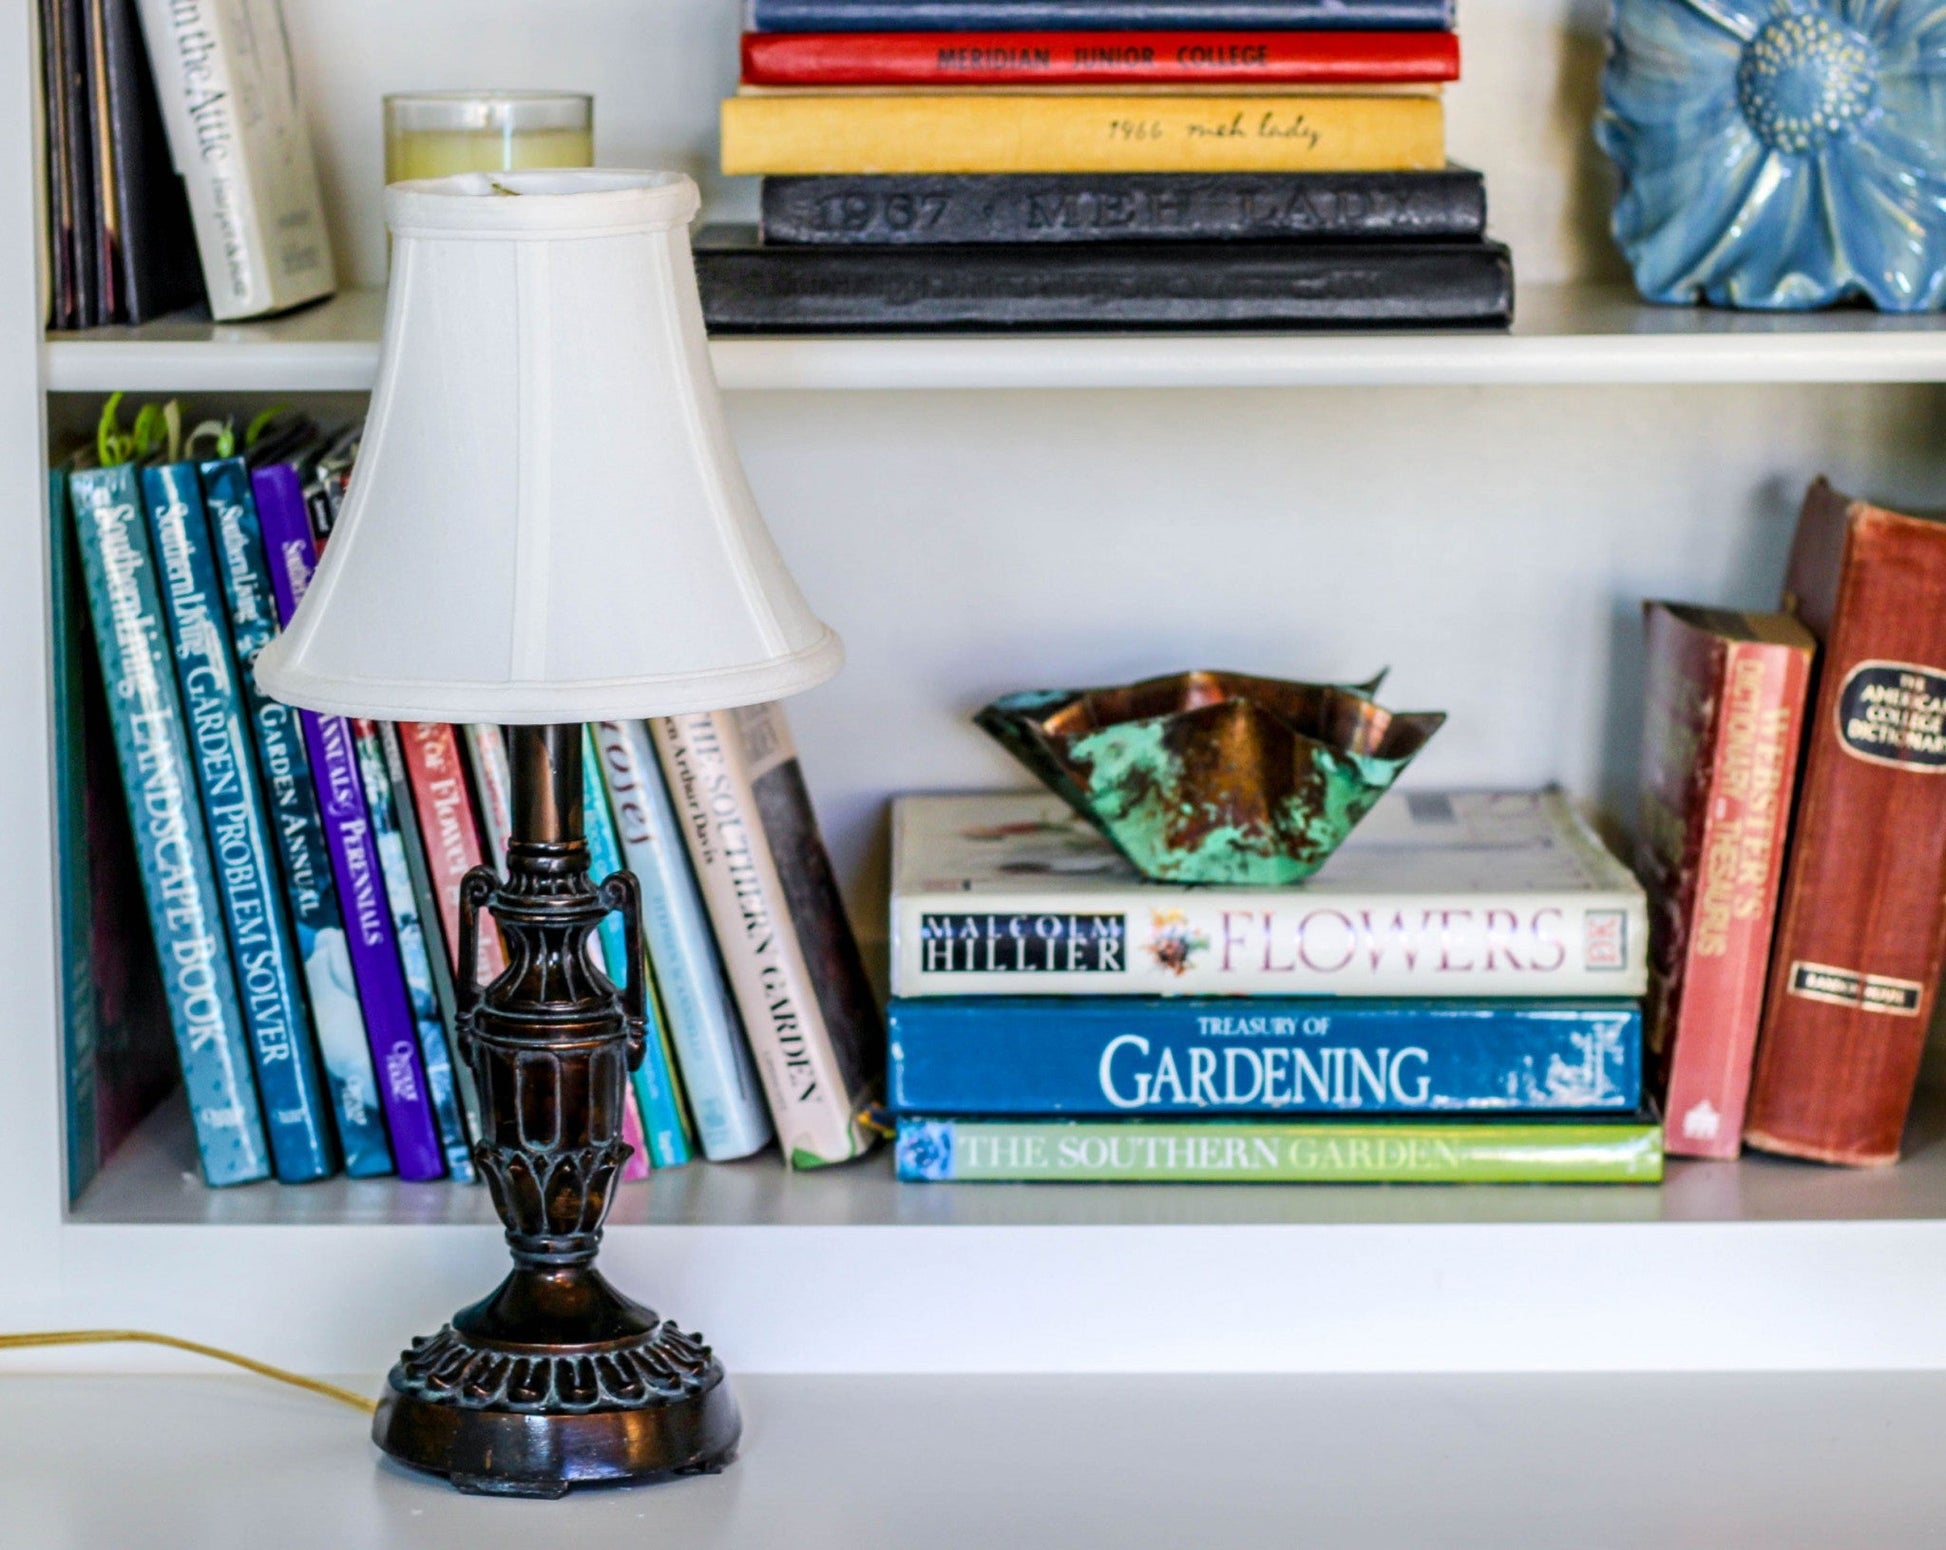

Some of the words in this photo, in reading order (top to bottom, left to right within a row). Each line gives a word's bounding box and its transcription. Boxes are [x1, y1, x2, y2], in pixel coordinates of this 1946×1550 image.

[178, 29, 218, 86] the
[937, 47, 1049, 70] MERIDIAN
[1073, 46, 1155, 68] JUNIOR
[1177, 45, 1268, 67] COLLEGE
[186, 88, 232, 161] Attic
[1110, 120, 1163, 140] 1966
[814, 191, 950, 232] 1967
[1026, 189, 1192, 230] MEH
[187, 665, 240, 796] GARDEN
[1722, 660, 1762, 797] DICTIONARY
[1860, 683, 1946, 712] AMERICA
[1866, 705, 1943, 734] COLLEGE
[258, 703, 299, 806] GARDEN
[1847, 717, 1946, 754] DICTIONAR
[674, 747, 699, 809] Arthur
[692, 813, 714, 865] Davis
[1735, 707, 1790, 919] WEBSTER'S
[132, 707, 201, 931] LANDSCAPE
[172, 934, 220, 1053] BOOK
[213, 802, 271, 946] PROBLEM
[278, 816, 321, 917] ANNUAL
[339, 816, 384, 947] PERENNIALS
[1701, 818, 1742, 956] THESAURUS
[709, 773, 771, 955] SOUTHERN
[761, 965, 819, 1102] GARDEN
[926, 914, 1122, 939] MALCOLM
[926, 938, 1122, 972] HILLIER
[1218, 907, 1568, 974] FLOWERS
[243, 951, 292, 1065] SOLVER
[1197, 1016, 1298, 1036] TREASURY
[1302, 1016, 1331, 1036] OF
[1099, 1034, 1431, 1109] GARDENING
[958, 1135, 1049, 1169] THE
[1057, 1135, 1282, 1169] SOUTHERN
[1288, 1136, 1462, 1170] GARDEN
